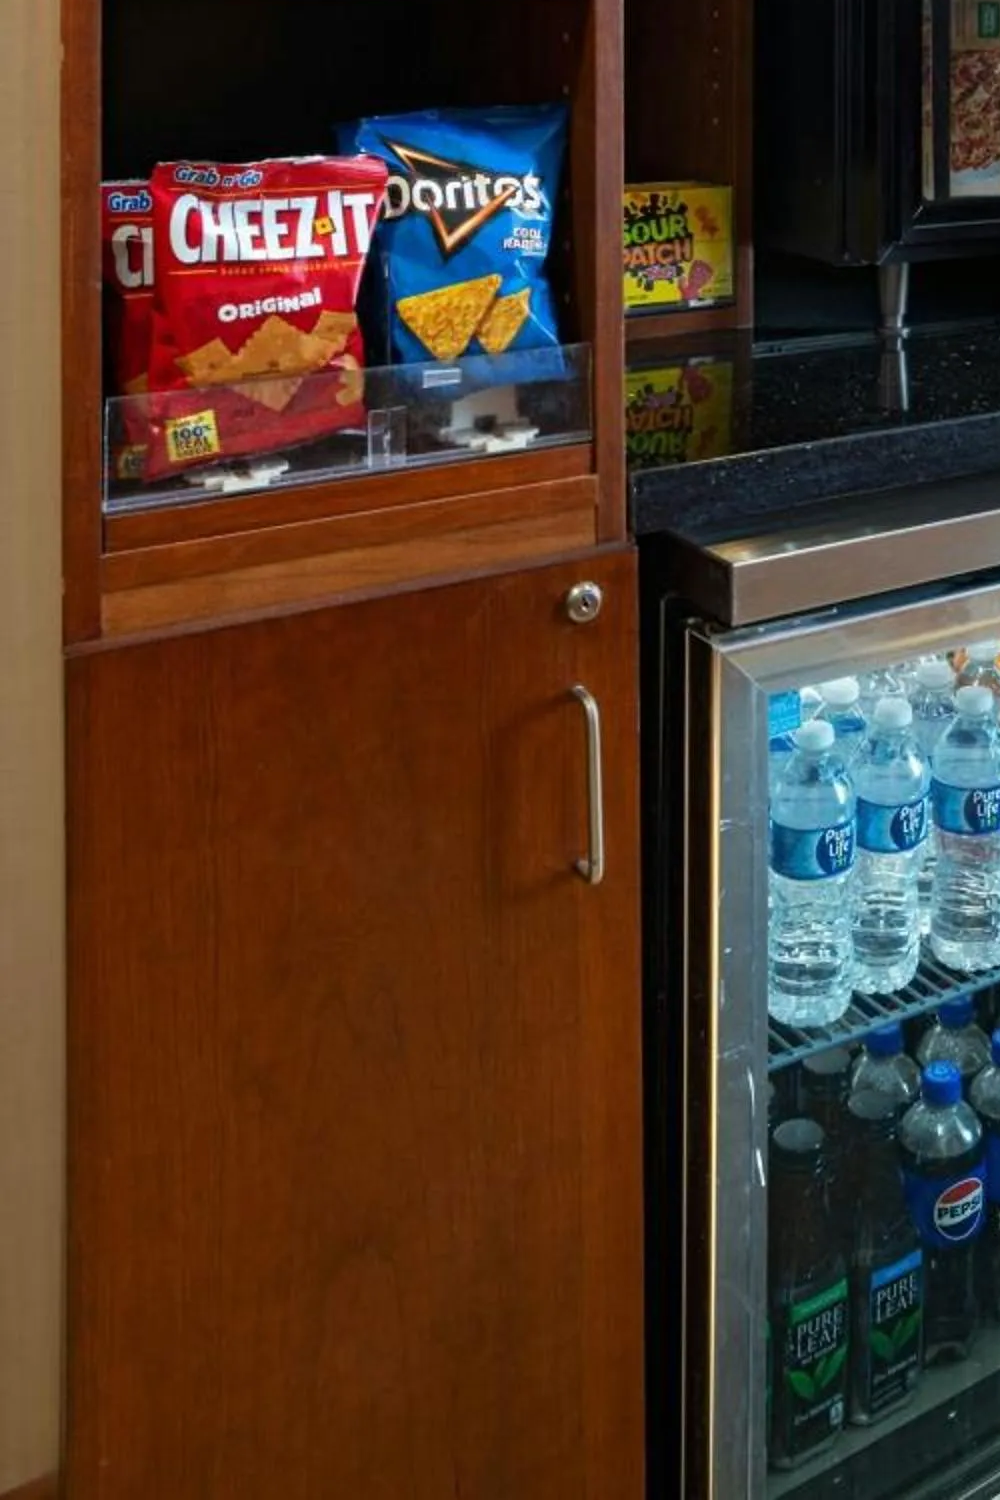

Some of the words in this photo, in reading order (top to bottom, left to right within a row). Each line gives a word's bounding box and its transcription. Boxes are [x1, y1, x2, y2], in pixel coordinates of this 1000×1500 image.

[176, 167, 220, 186] Grab
[109, 190, 152, 212] Grab
[384, 173, 541, 218] Doritos
